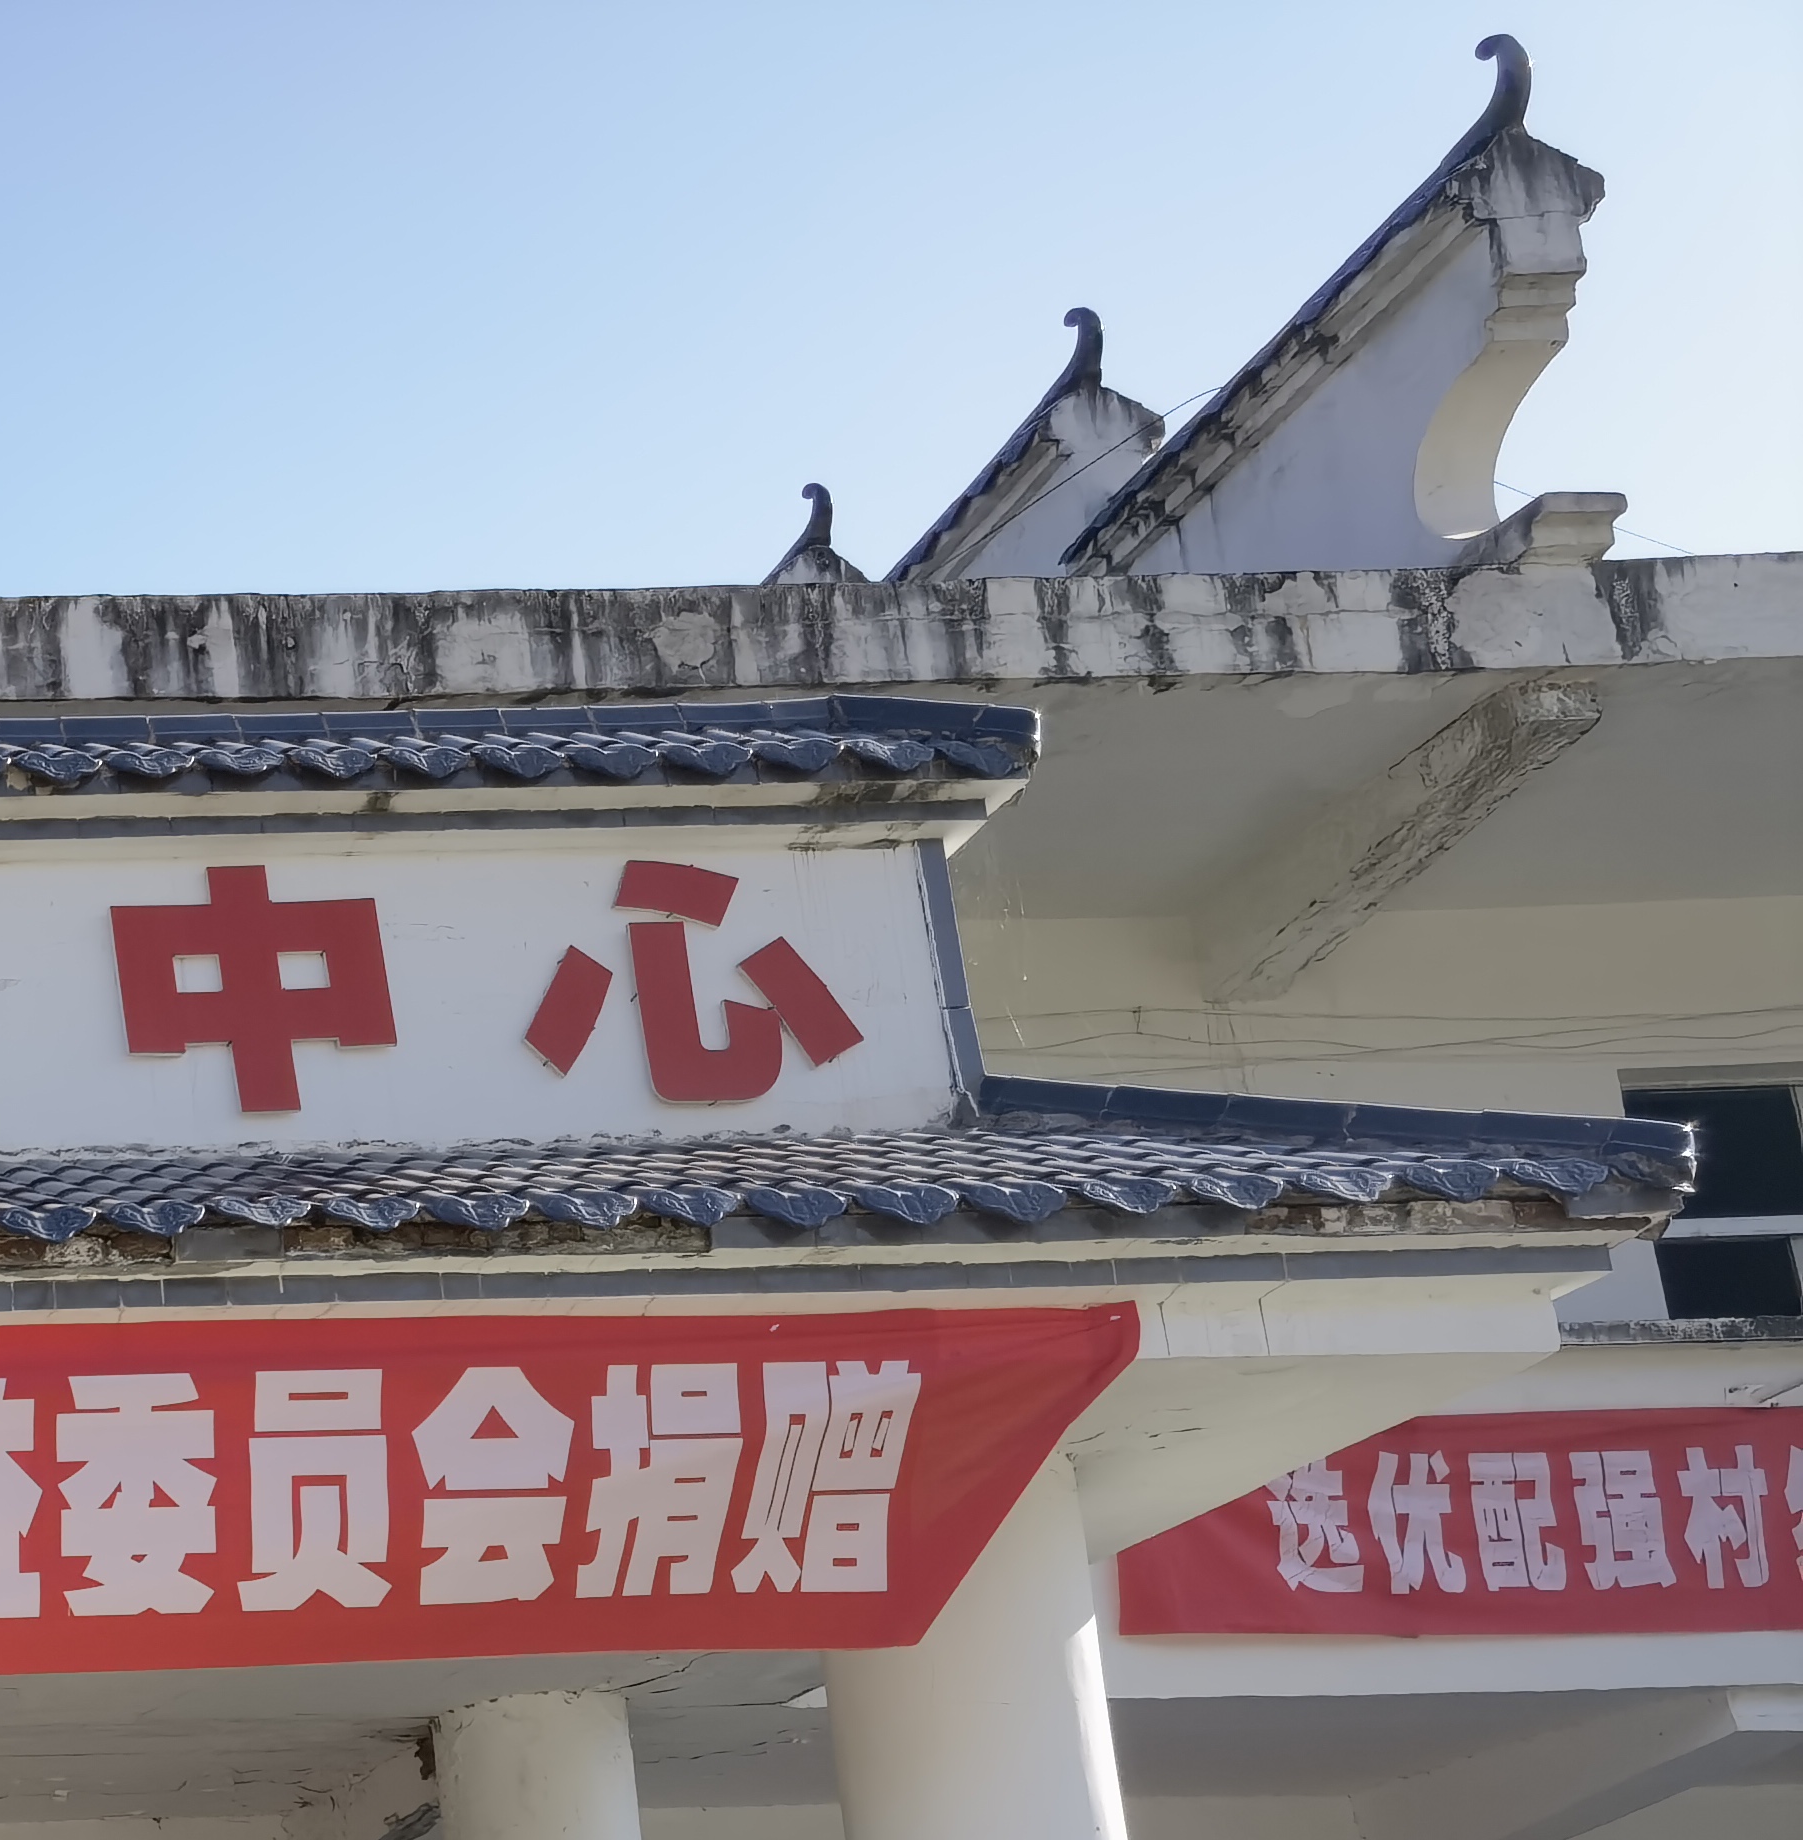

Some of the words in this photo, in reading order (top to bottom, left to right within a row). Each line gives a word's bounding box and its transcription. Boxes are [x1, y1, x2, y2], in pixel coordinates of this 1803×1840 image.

[1265, 1445, 1803, 1595] 选优配强村
